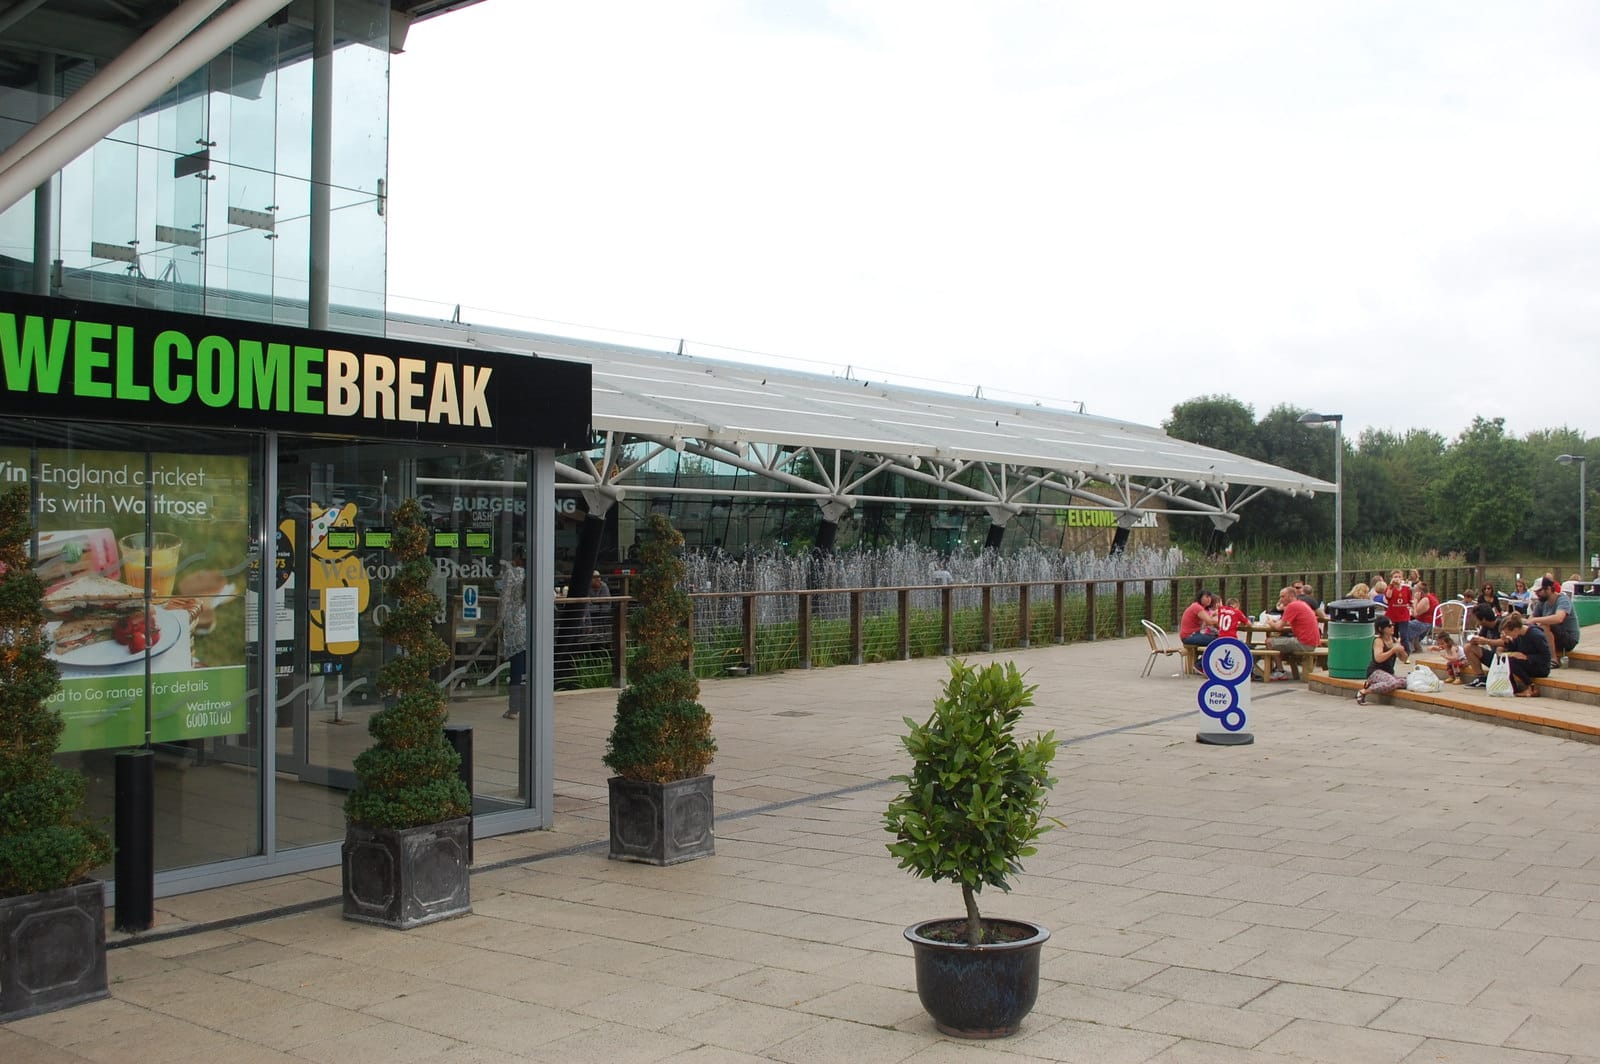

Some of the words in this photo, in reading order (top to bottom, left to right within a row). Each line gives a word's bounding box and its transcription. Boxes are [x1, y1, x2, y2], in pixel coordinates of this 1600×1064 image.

[41, 463, 128, 489] England
[132, 469, 205, 487] cricket
[62, 493, 106, 513] with
[452, 497, 527, 512] BURGER
[435, 557, 493, 578] Break
[1219, 614, 1231, 631] 10
[69, 689, 82, 701] to
[84, 688, 104, 700] Go
[106, 686, 143, 699] range
[151, 683, 168, 695] for
[170, 680, 209, 694] details
[1210, 691, 1226, 699] Play
[186, 700, 232, 711] Waitrose
[186, 712, 208, 728] GOOD
[209, 711, 219, 726] TO
[220, 710, 231, 725] GO
